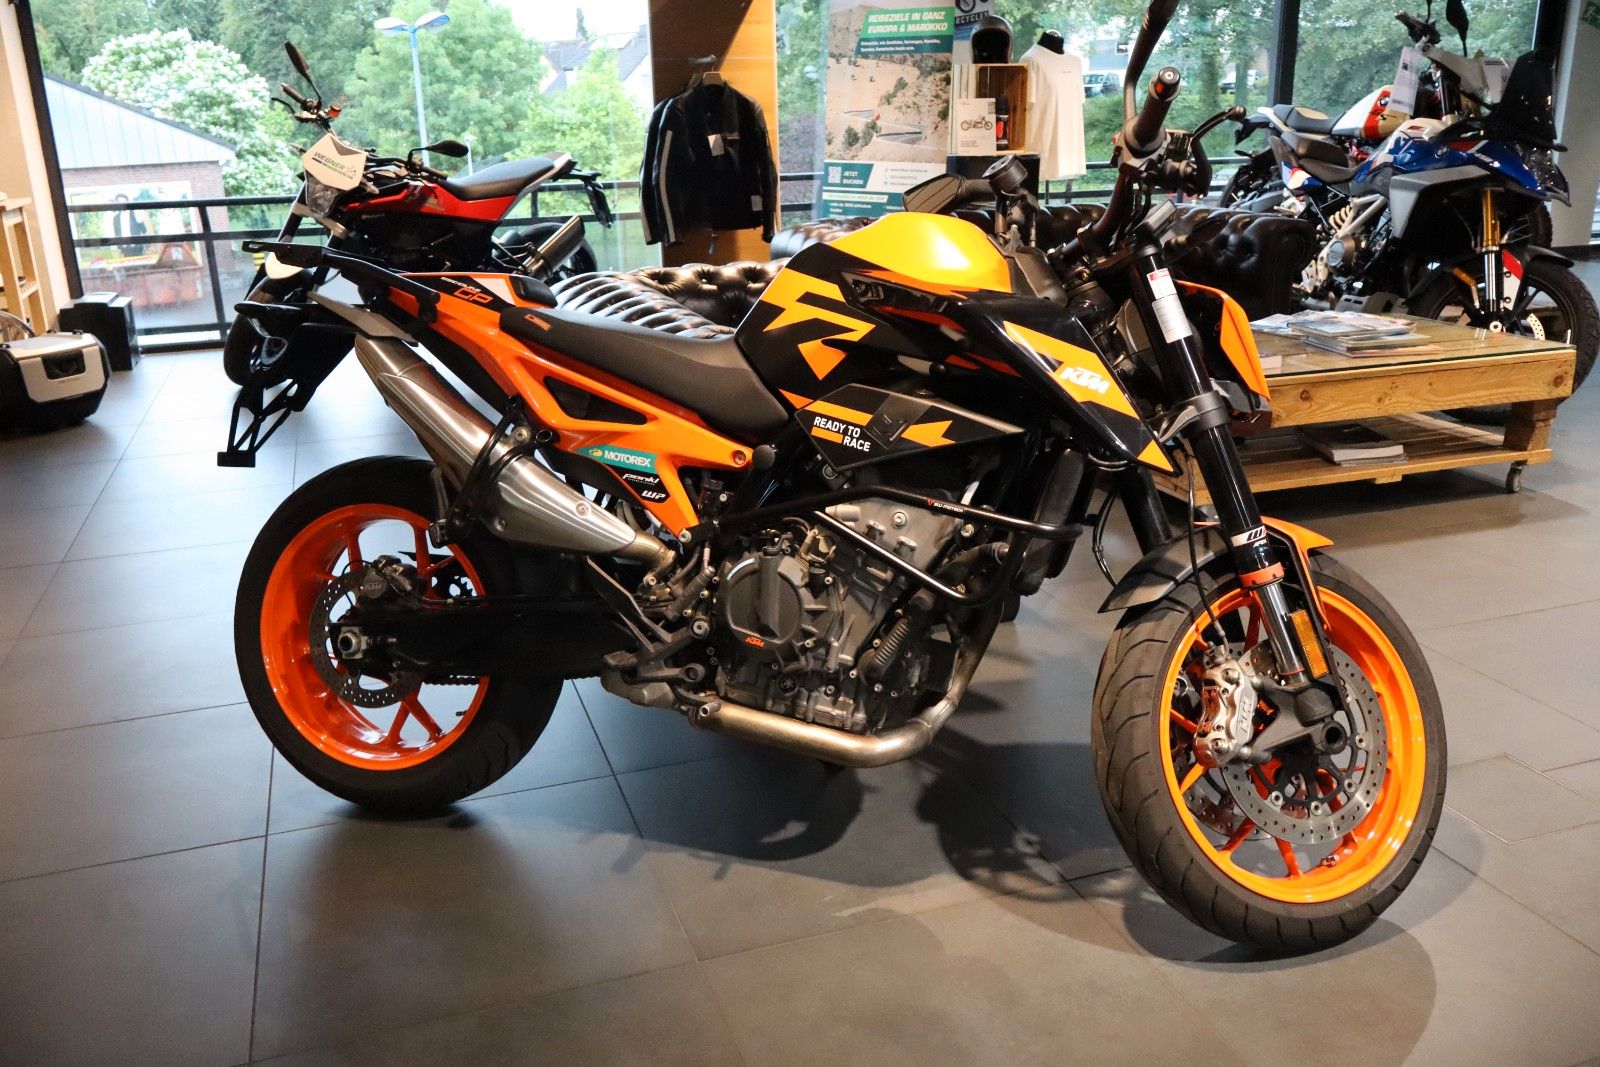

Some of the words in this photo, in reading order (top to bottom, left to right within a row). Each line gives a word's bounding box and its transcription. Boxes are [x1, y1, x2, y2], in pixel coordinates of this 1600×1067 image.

[868, 13, 910, 22] REISEZIELE
[911, 12, 921, 21] IN
[922, 11, 946, 20] GANZ
[867, 24, 898, 33] EUROPA
[907, 22, 948, 32] MAROKKO
[314, 151, 346, 171] WEGNER
[453, 287, 494, 304] GP
[1059, 366, 1111, 395] KTM
[813, 416, 847, 433] READY
[847, 425, 861, 438] TO
[843, 435, 872, 453] RACE
[603, 449, 651, 468] MOTOREX
[641, 489, 666, 500] WP
